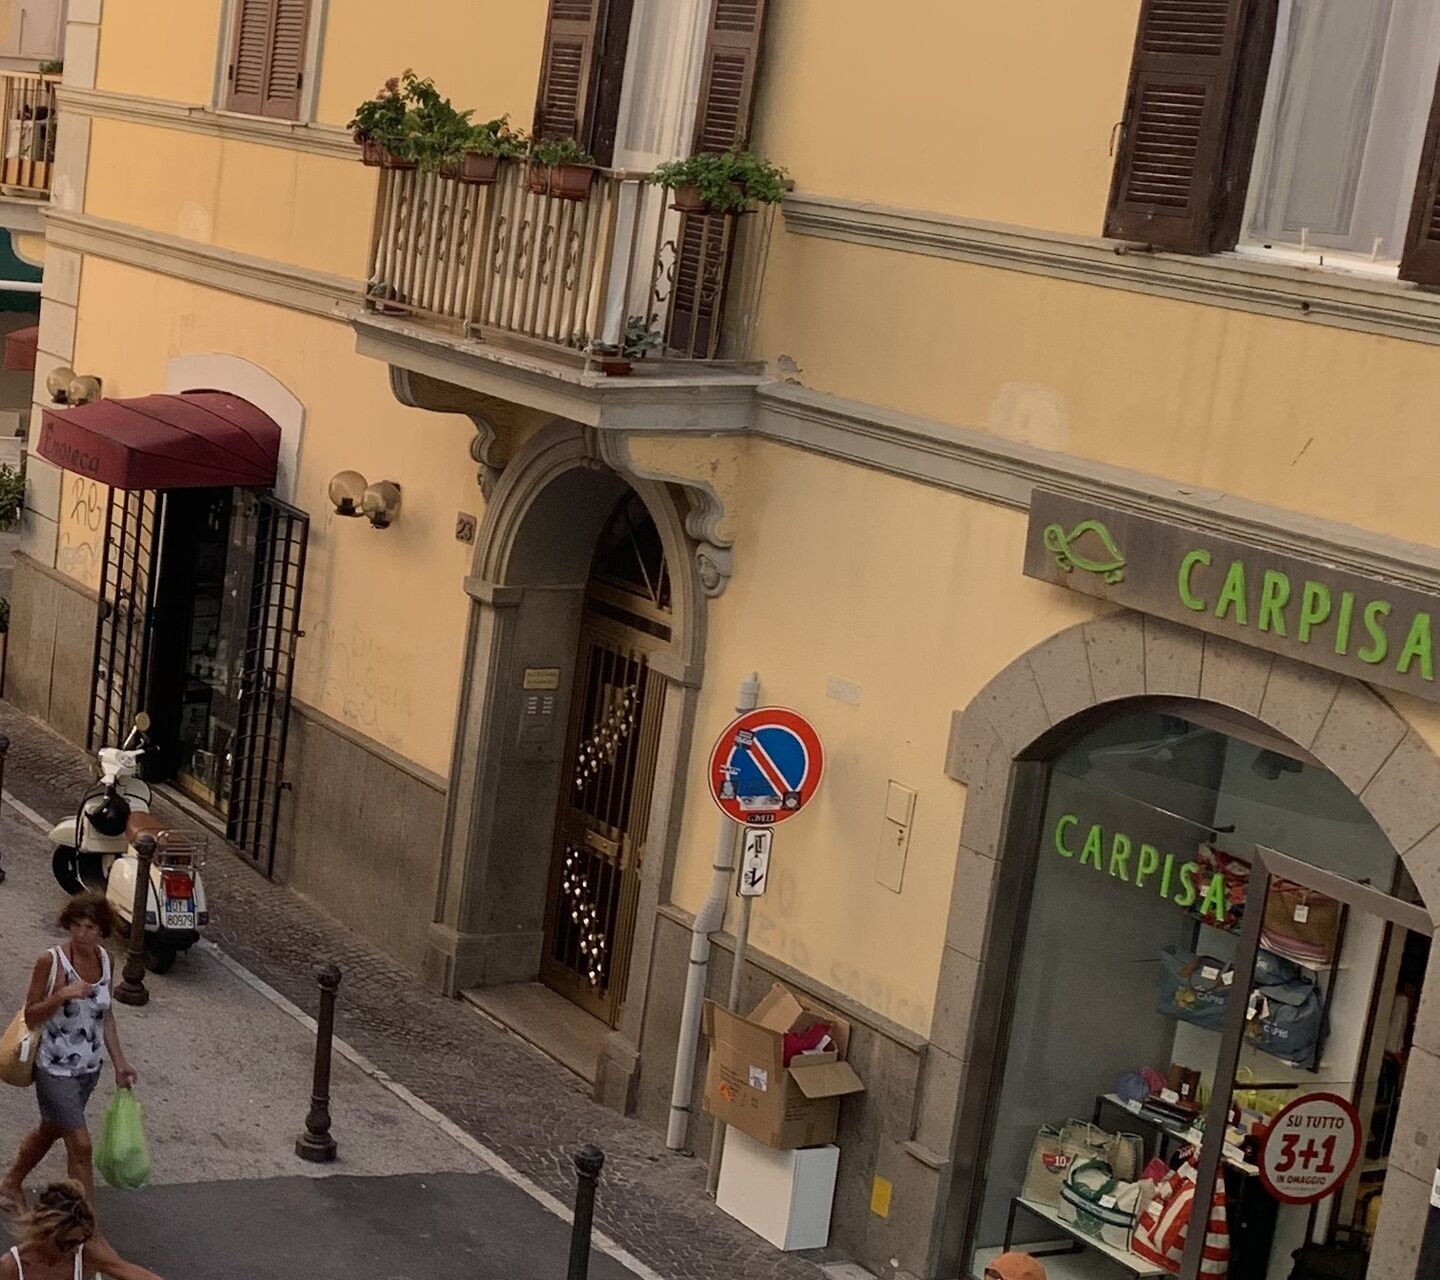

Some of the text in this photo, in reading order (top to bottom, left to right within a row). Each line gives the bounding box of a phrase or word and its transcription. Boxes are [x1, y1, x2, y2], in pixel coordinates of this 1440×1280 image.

[1177, 549, 1435, 682] CARPISA
[1054, 813, 1225, 923] CARPISA
[1286, 1114, 1345, 1130] SU TUTTO
[1274, 1133, 1338, 1174] 3+1
[1286, 1175, 1327, 1186] OMAGGIO
